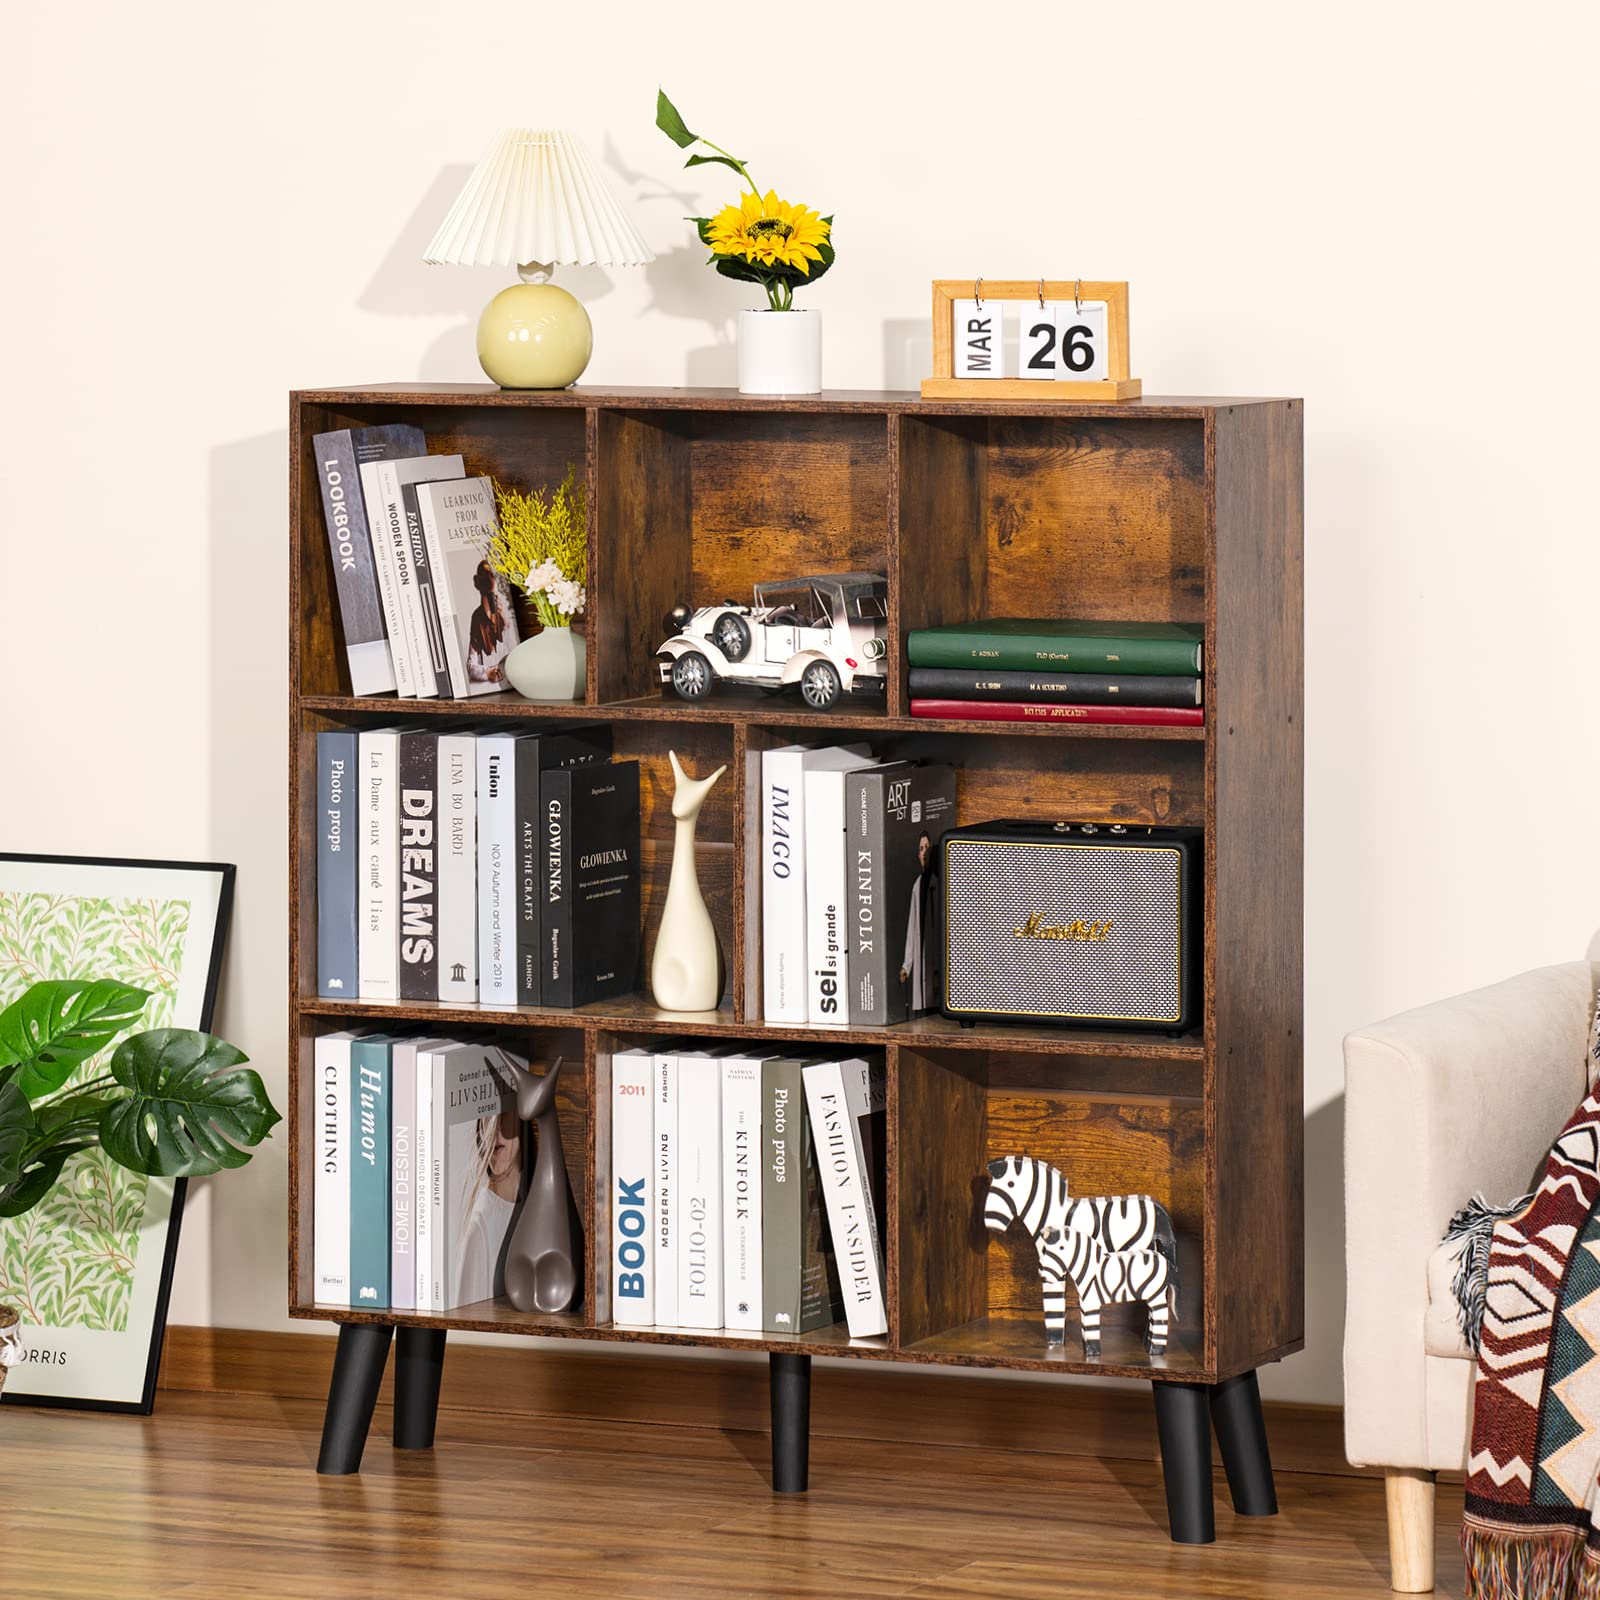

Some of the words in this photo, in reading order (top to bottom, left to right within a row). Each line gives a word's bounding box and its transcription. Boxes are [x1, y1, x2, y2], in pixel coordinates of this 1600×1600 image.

[967, 318, 992, 371] MAR
[1027, 323, 1095, 372] 26
[324, 459, 356, 573] LOOKBOOK
[443, 492, 484, 508] LEARNING
[455, 509, 478, 523] FROM
[387, 502, 404, 548] WOODEN
[396, 550, 410, 586] SPOON
[407, 511, 426, 567] FASHION
[448, 526, 466, 540] LAS
[331, 759, 345, 804] Photo
[370, 751, 382, 768] La
[451, 753, 463, 786] LINA
[489, 755, 501, 799] Union
[370, 777, 382, 812] Dame
[451, 792, 463, 810] BO
[887, 781, 911, 809] ART
[327, 809, 341, 852] props
[370, 820, 380, 846] aux
[451, 816, 464, 856] BARDI
[523, 821, 532, 850] ARTS
[771, 784, 790, 880] IMAGO
[370, 854, 382, 889] camé
[401, 788, 434, 964] DREAMS
[524, 853, 533, 875] THE
[492, 869, 501, 908] Autumn
[524, 877, 533, 921] CRAFTS
[857, 849, 873, 954] KINFOLK
[370, 900, 383, 932] lias
[492, 909, 501, 930] and
[824, 903, 838, 952] grande
[493, 931, 502, 964] Winter
[824, 950, 838, 967] si
[494, 964, 503, 989] 2018
[815, 969, 838, 1015] sei
[458, 1069, 481, 1083] Gunnel
[619, 1084, 646, 1097] 2011
[324, 1065, 338, 1174] CLOTHING
[359, 1064, 381, 1166] Humor
[477, 1102, 497, 1114] corset
[775, 1087, 788, 1133] Photo
[396, 1125, 409, 1195] DESIGN
[661, 1133, 669, 1181] LIVING
[772, 1139, 786, 1183] props
[820, 1093, 852, 1189] FASHION
[736, 1130, 749, 1220] KINFOLK
[396, 1201, 409, 1254] HOME
[418, 1184, 426, 1236] DECORATES
[661, 1187, 669, 1248] MODERN
[618, 1176, 645, 1299] BOOK
[689, 1197, 707, 1297] FOLIO-02
[322, 1276, 344, 1285] Better
